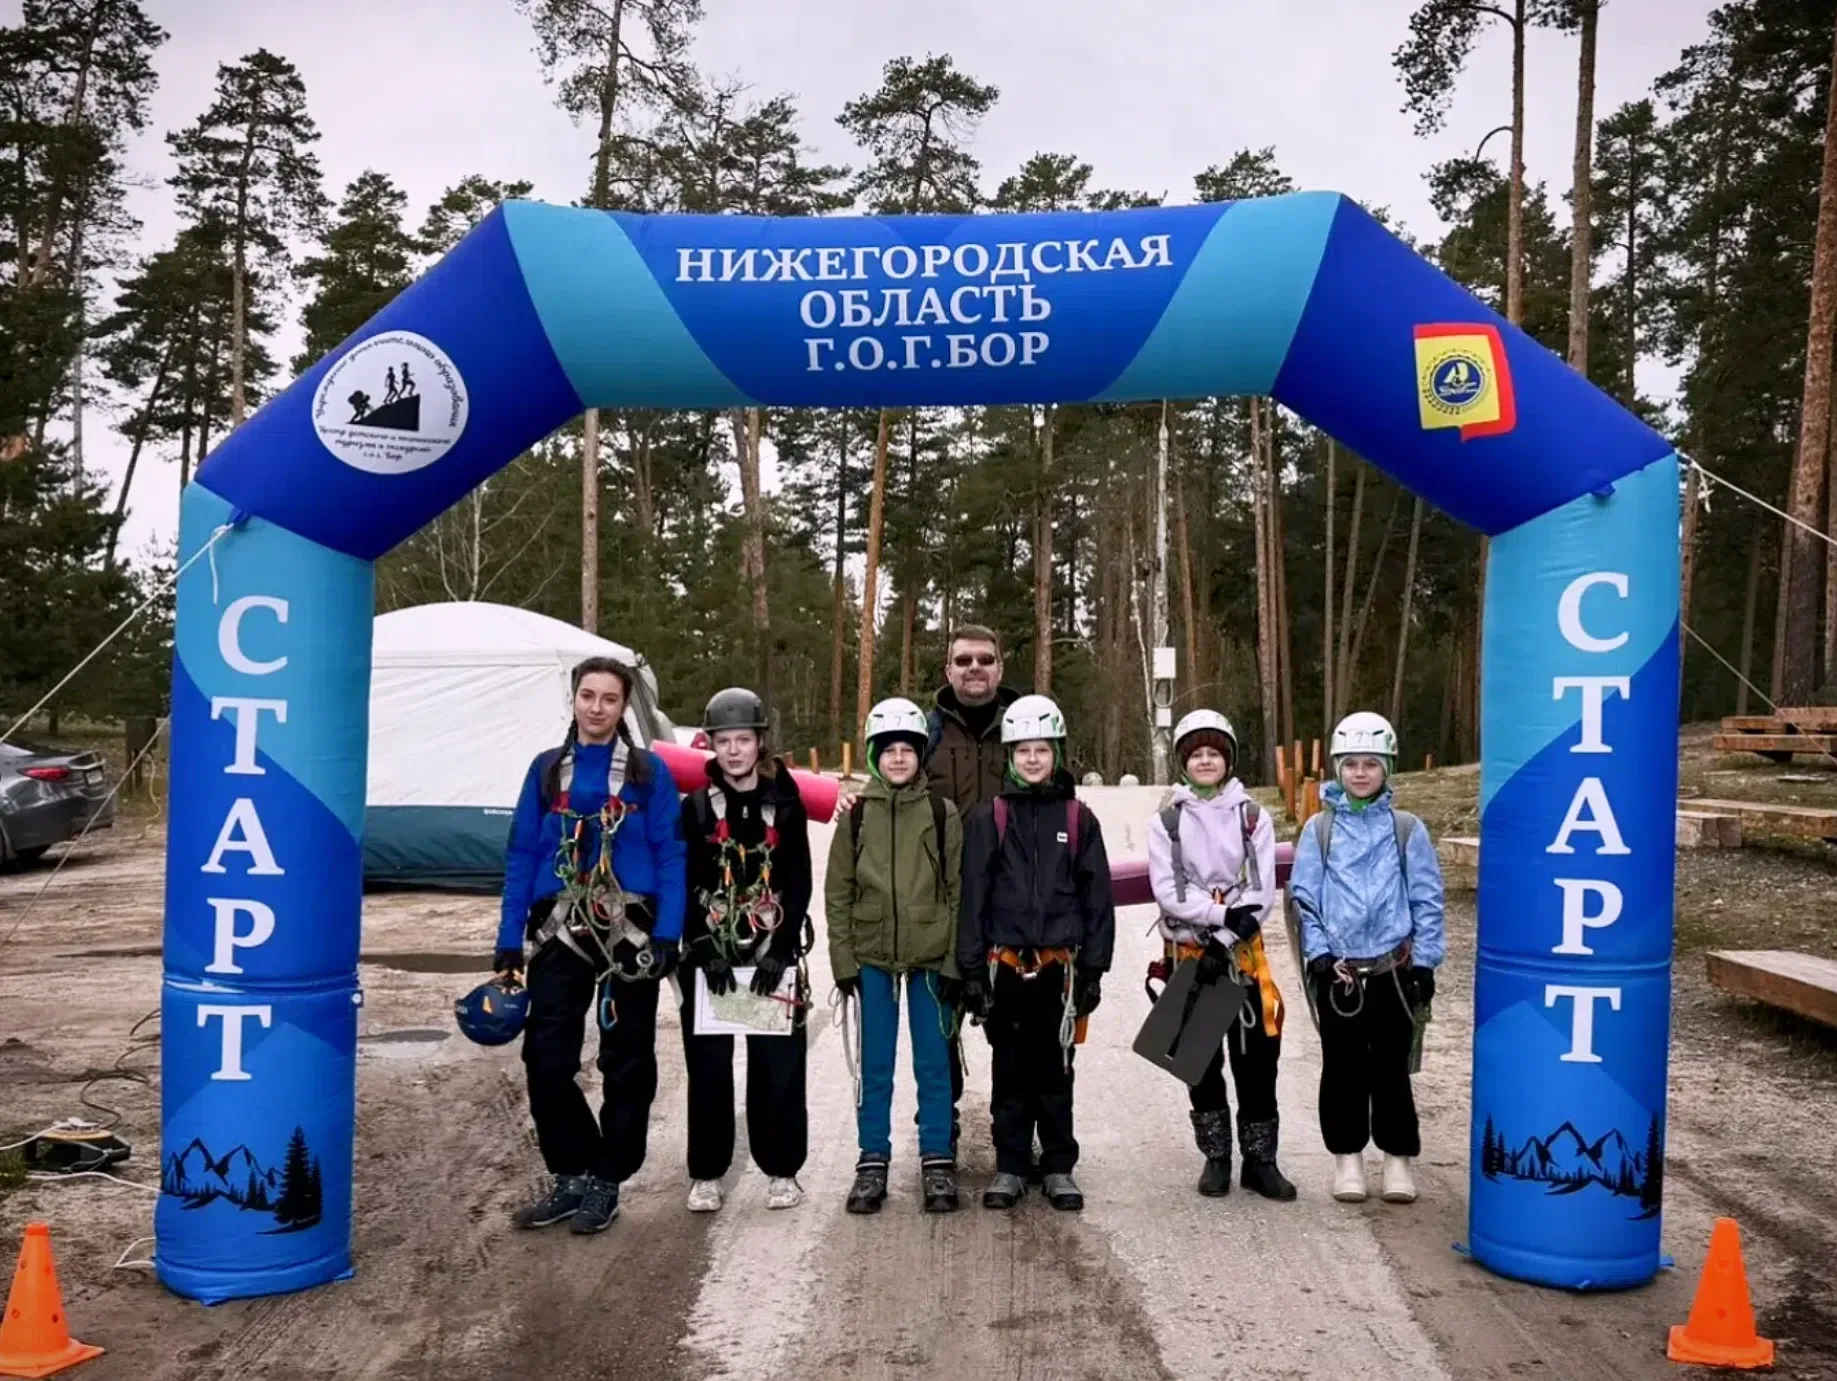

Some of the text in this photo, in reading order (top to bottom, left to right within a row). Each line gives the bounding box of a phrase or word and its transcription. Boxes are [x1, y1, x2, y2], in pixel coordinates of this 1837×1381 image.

[676, 234, 1173, 284] НИЖЕГОРОДСКАЯ
[801, 284, 1051, 327] ОБЛАСТЬ
[807, 332, 1049, 370] Г.О.Г.БОР
[1355, 731, 1364, 743] 7
[197, 595, 289, 1080] СТАРТ
[1545, 571, 1631, 1063] СТАРТ
